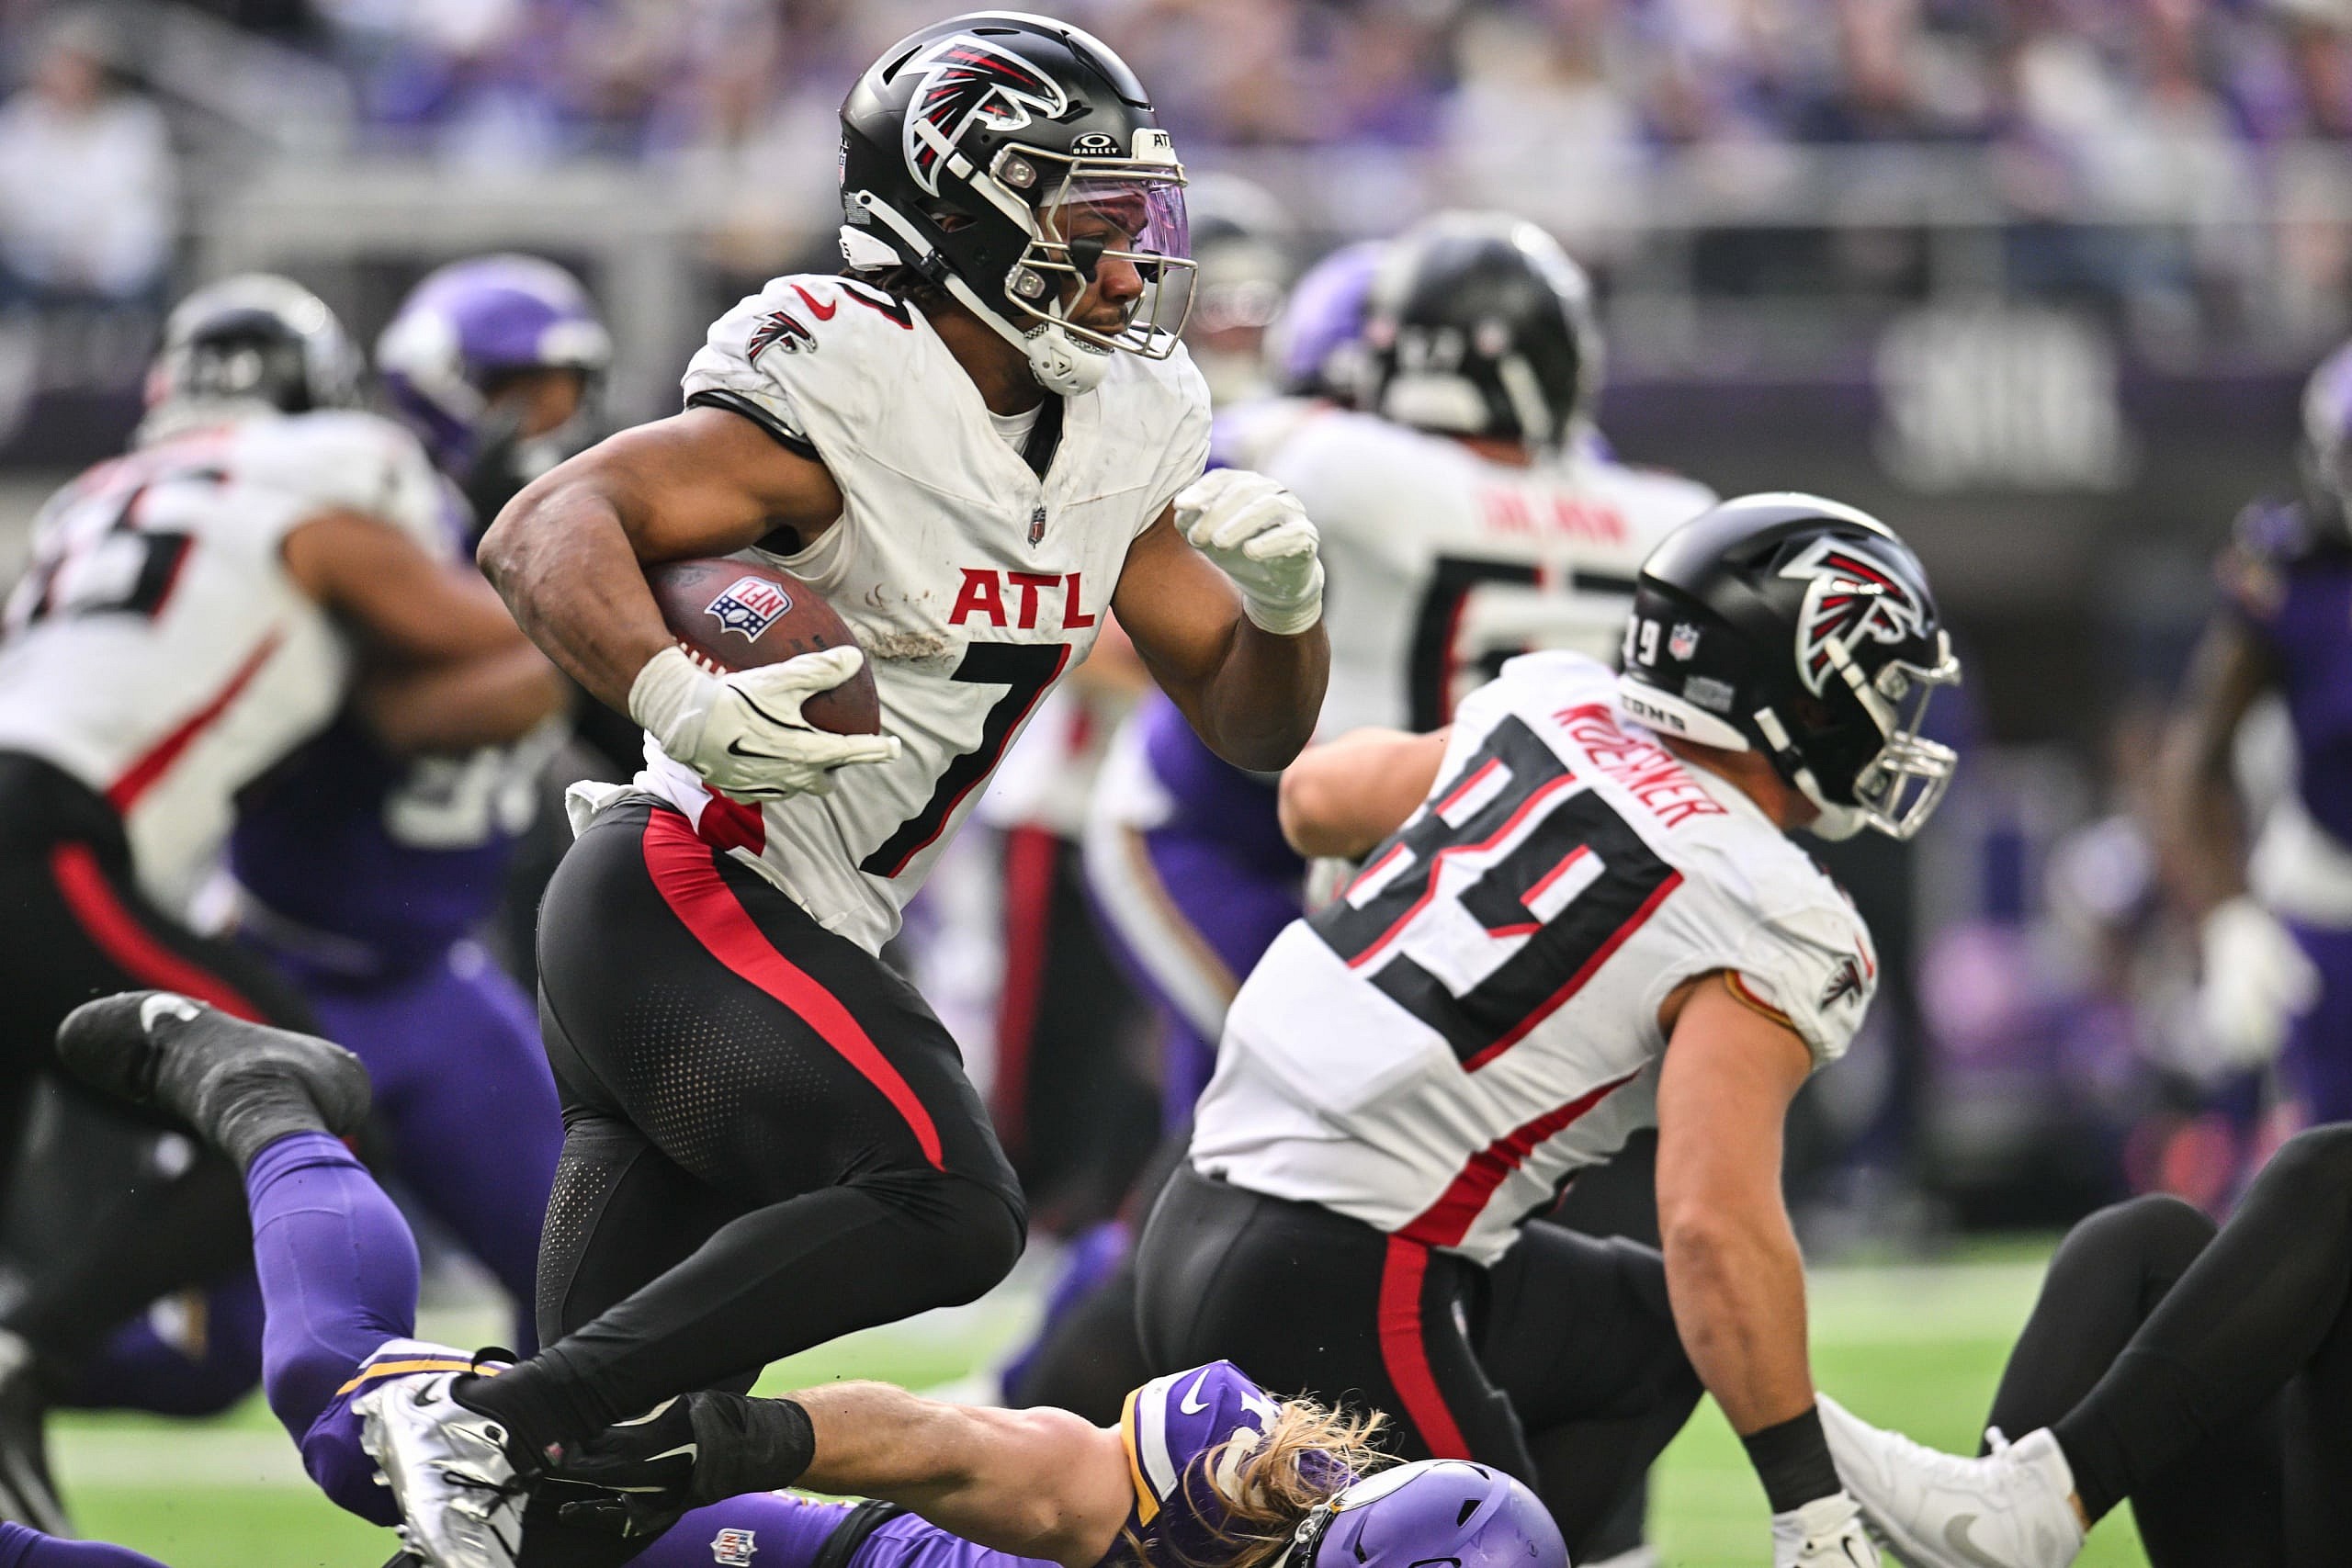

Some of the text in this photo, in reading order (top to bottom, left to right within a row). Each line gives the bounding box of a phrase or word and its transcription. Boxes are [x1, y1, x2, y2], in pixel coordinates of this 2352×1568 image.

[1072, 147, 1119, 155] OAKLEY
[736, 581, 784, 617] NFL
[947, 567, 1095, 629] ATL
[859, 641, 1072, 879] 7
[1306, 713, 1683, 1073] 89
[719, 1535, 738, 1559] NFL
